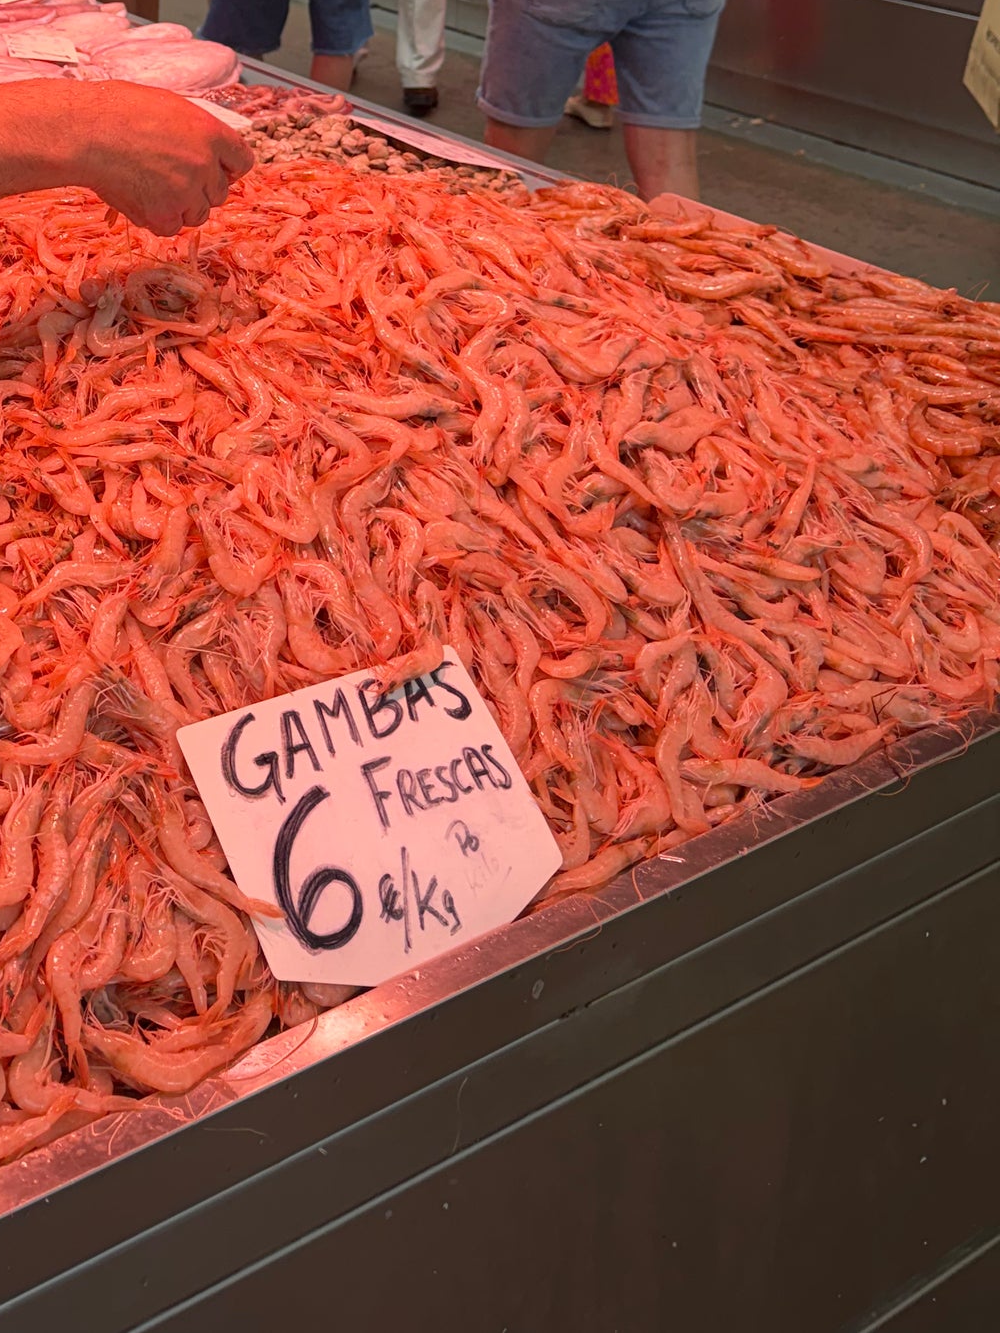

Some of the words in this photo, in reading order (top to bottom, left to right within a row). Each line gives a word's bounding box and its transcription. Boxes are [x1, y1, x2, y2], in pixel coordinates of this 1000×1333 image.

[221, 661, 473, 806] GAMBAS
[360, 743, 513, 833] FRESCAS
[272, 785, 364, 956] 6
